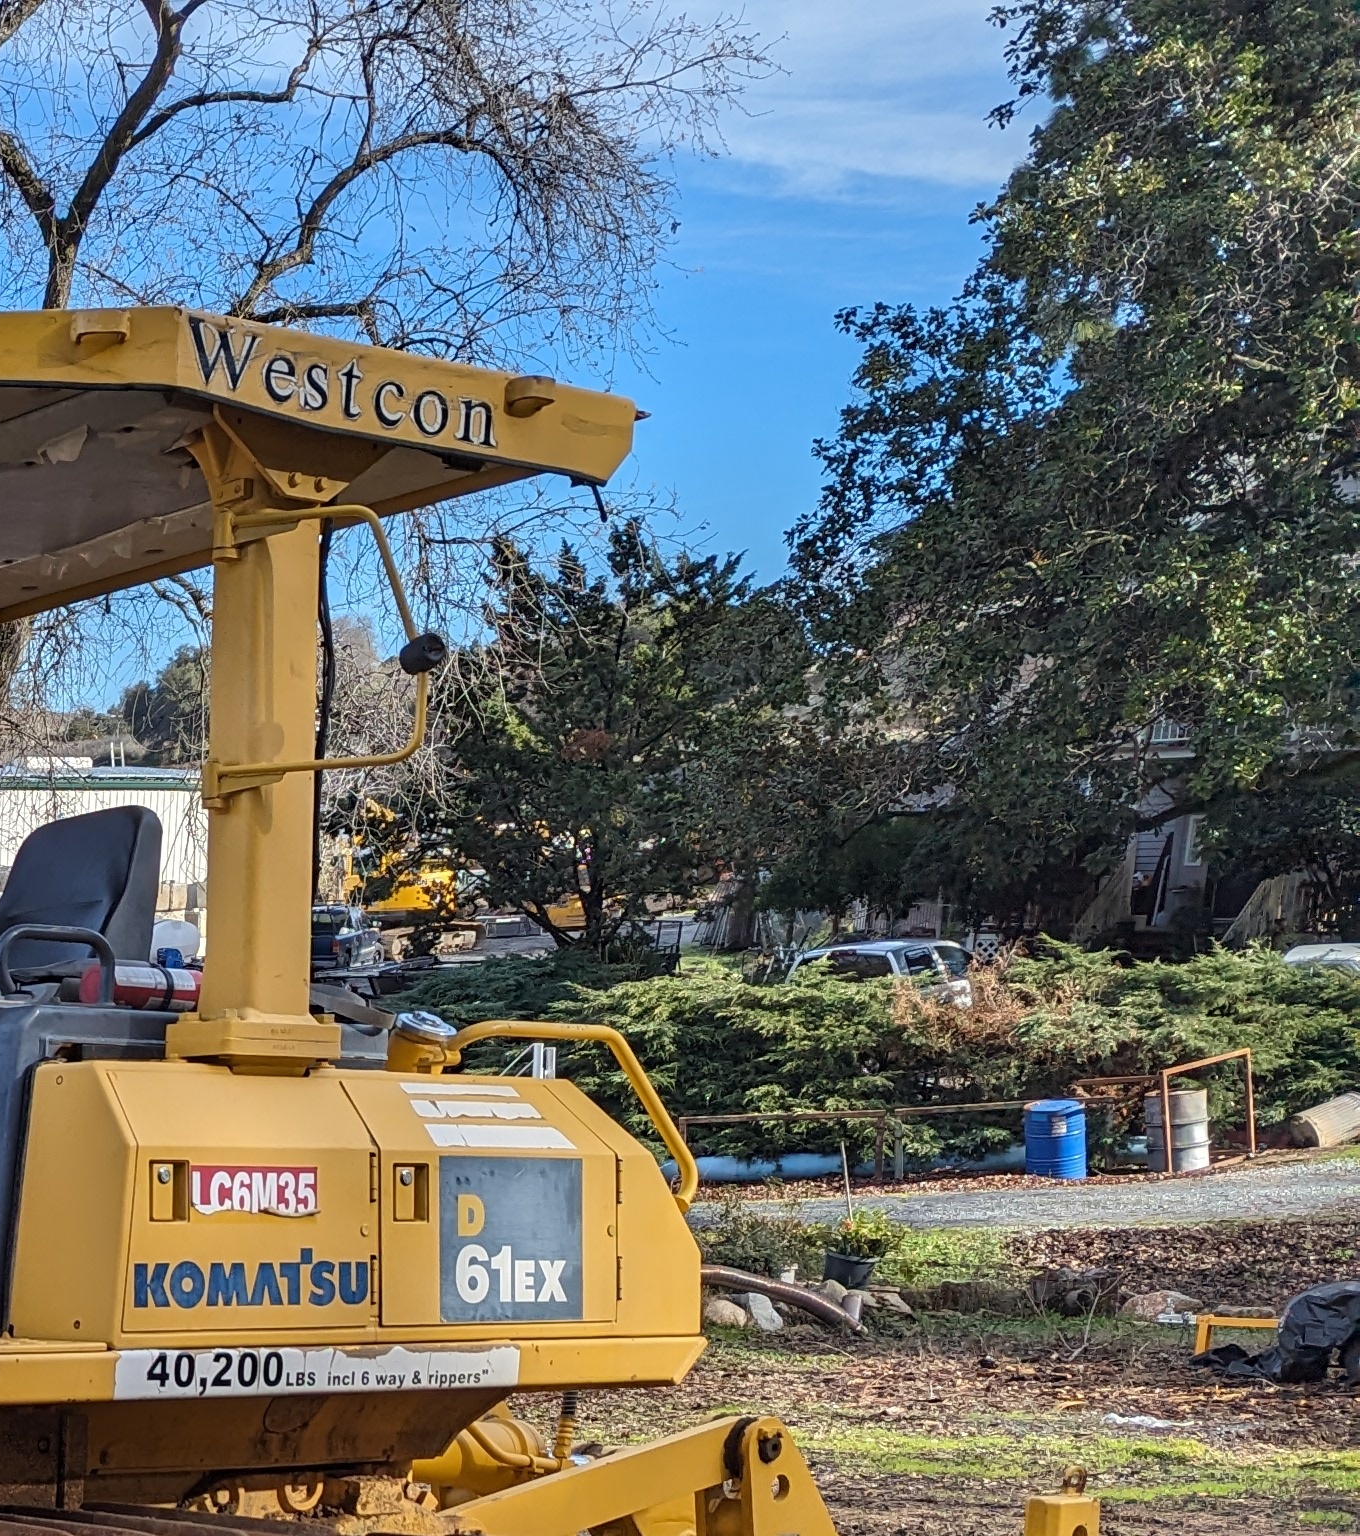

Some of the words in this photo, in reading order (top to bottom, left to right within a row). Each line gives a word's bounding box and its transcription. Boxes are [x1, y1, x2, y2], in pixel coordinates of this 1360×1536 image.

[189, 316, 497, 447] Westcon
[192, 1171, 316, 1214] LC6M35
[458, 1194, 485, 1237] D
[134, 1248, 369, 1309] KOMATSU
[455, 1244, 568, 1303] 61EX
[146, 1351, 284, 1396] 40,200
[285, 1372, 316, 1387] LBS
[327, 1371, 355, 1386] incl
[361, 1371, 370, 1386] 6
[375, 1375, 406, 1389] way
[411, 1370, 422, 1384] &
